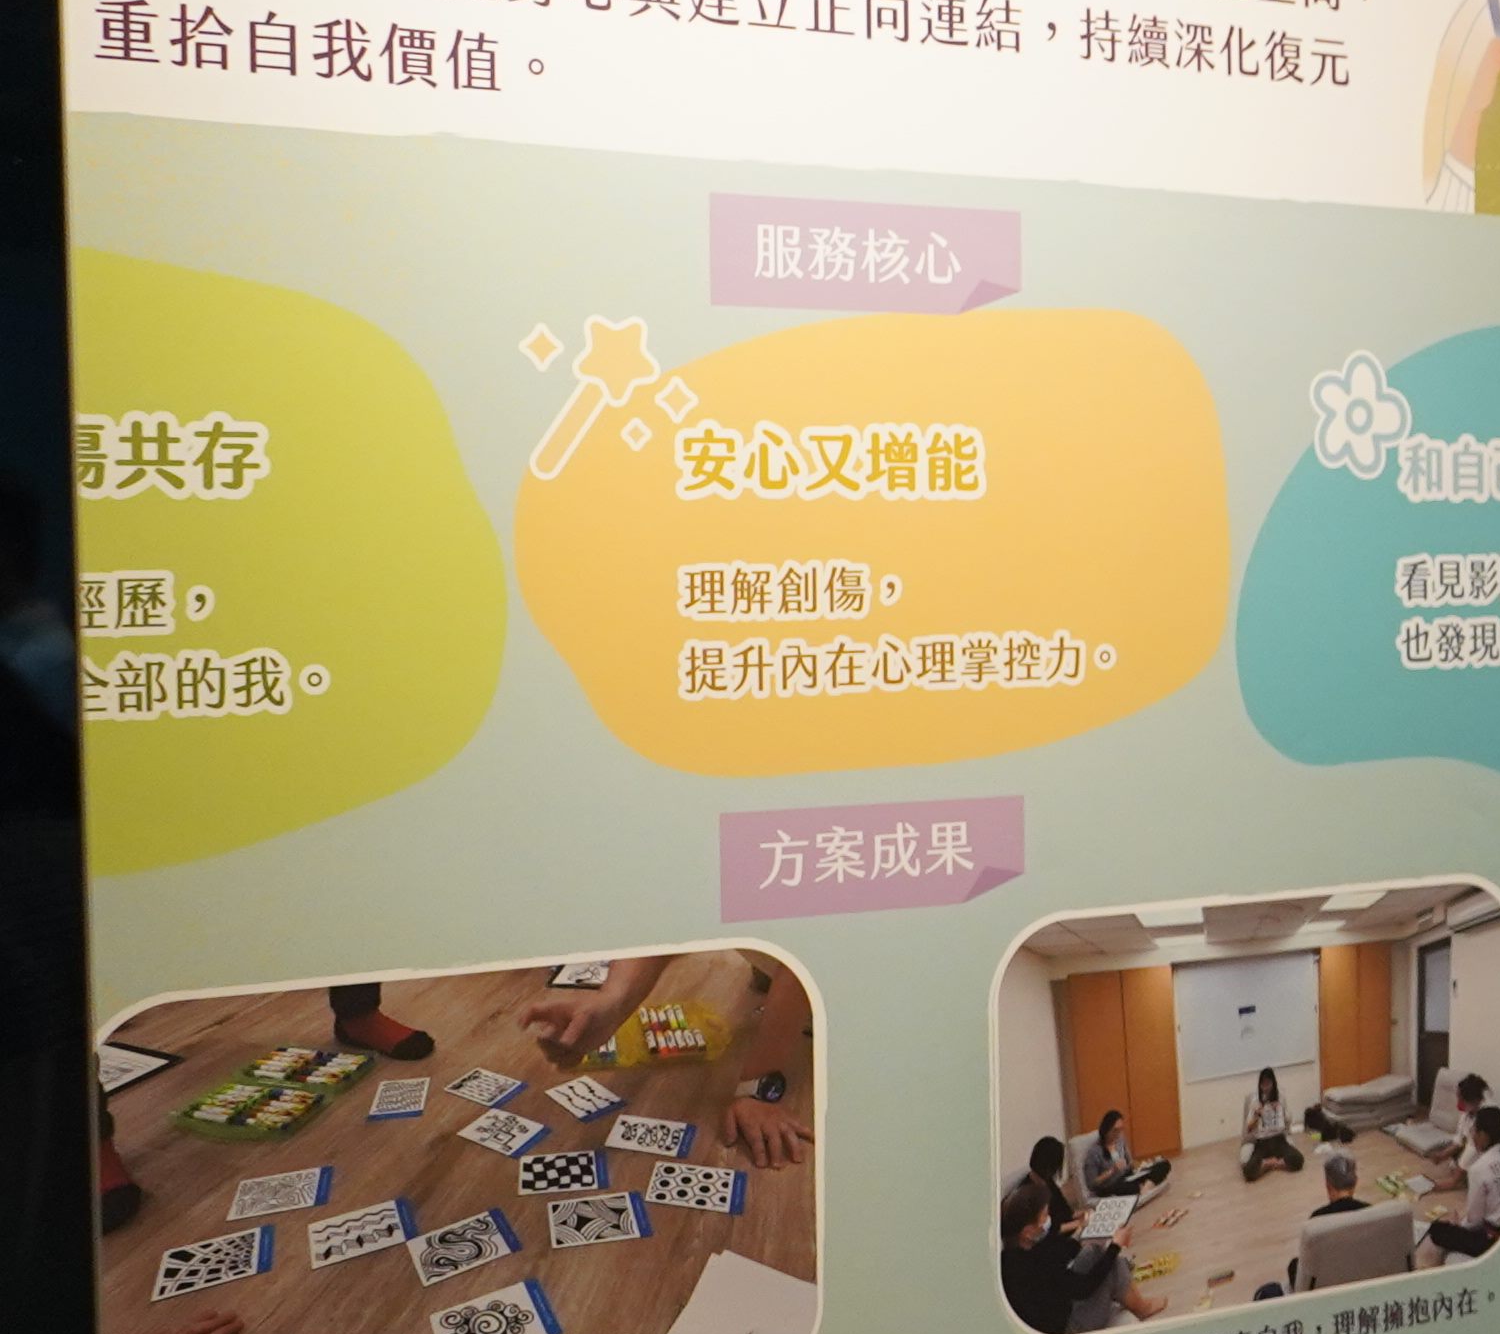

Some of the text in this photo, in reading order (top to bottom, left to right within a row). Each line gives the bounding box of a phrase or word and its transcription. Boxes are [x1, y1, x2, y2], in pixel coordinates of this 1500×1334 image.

[93, 0, 546, 95] 重拾自我價值。
[753, 223, 963, 289] 服務核心
[681, 429, 981, 497] 安心又增能
[683, 565, 902, 617] 理解創傷，
[683, 636, 1117, 696] 提升內在心理掌控力。
[758, 819, 975, 891] 方案成果
